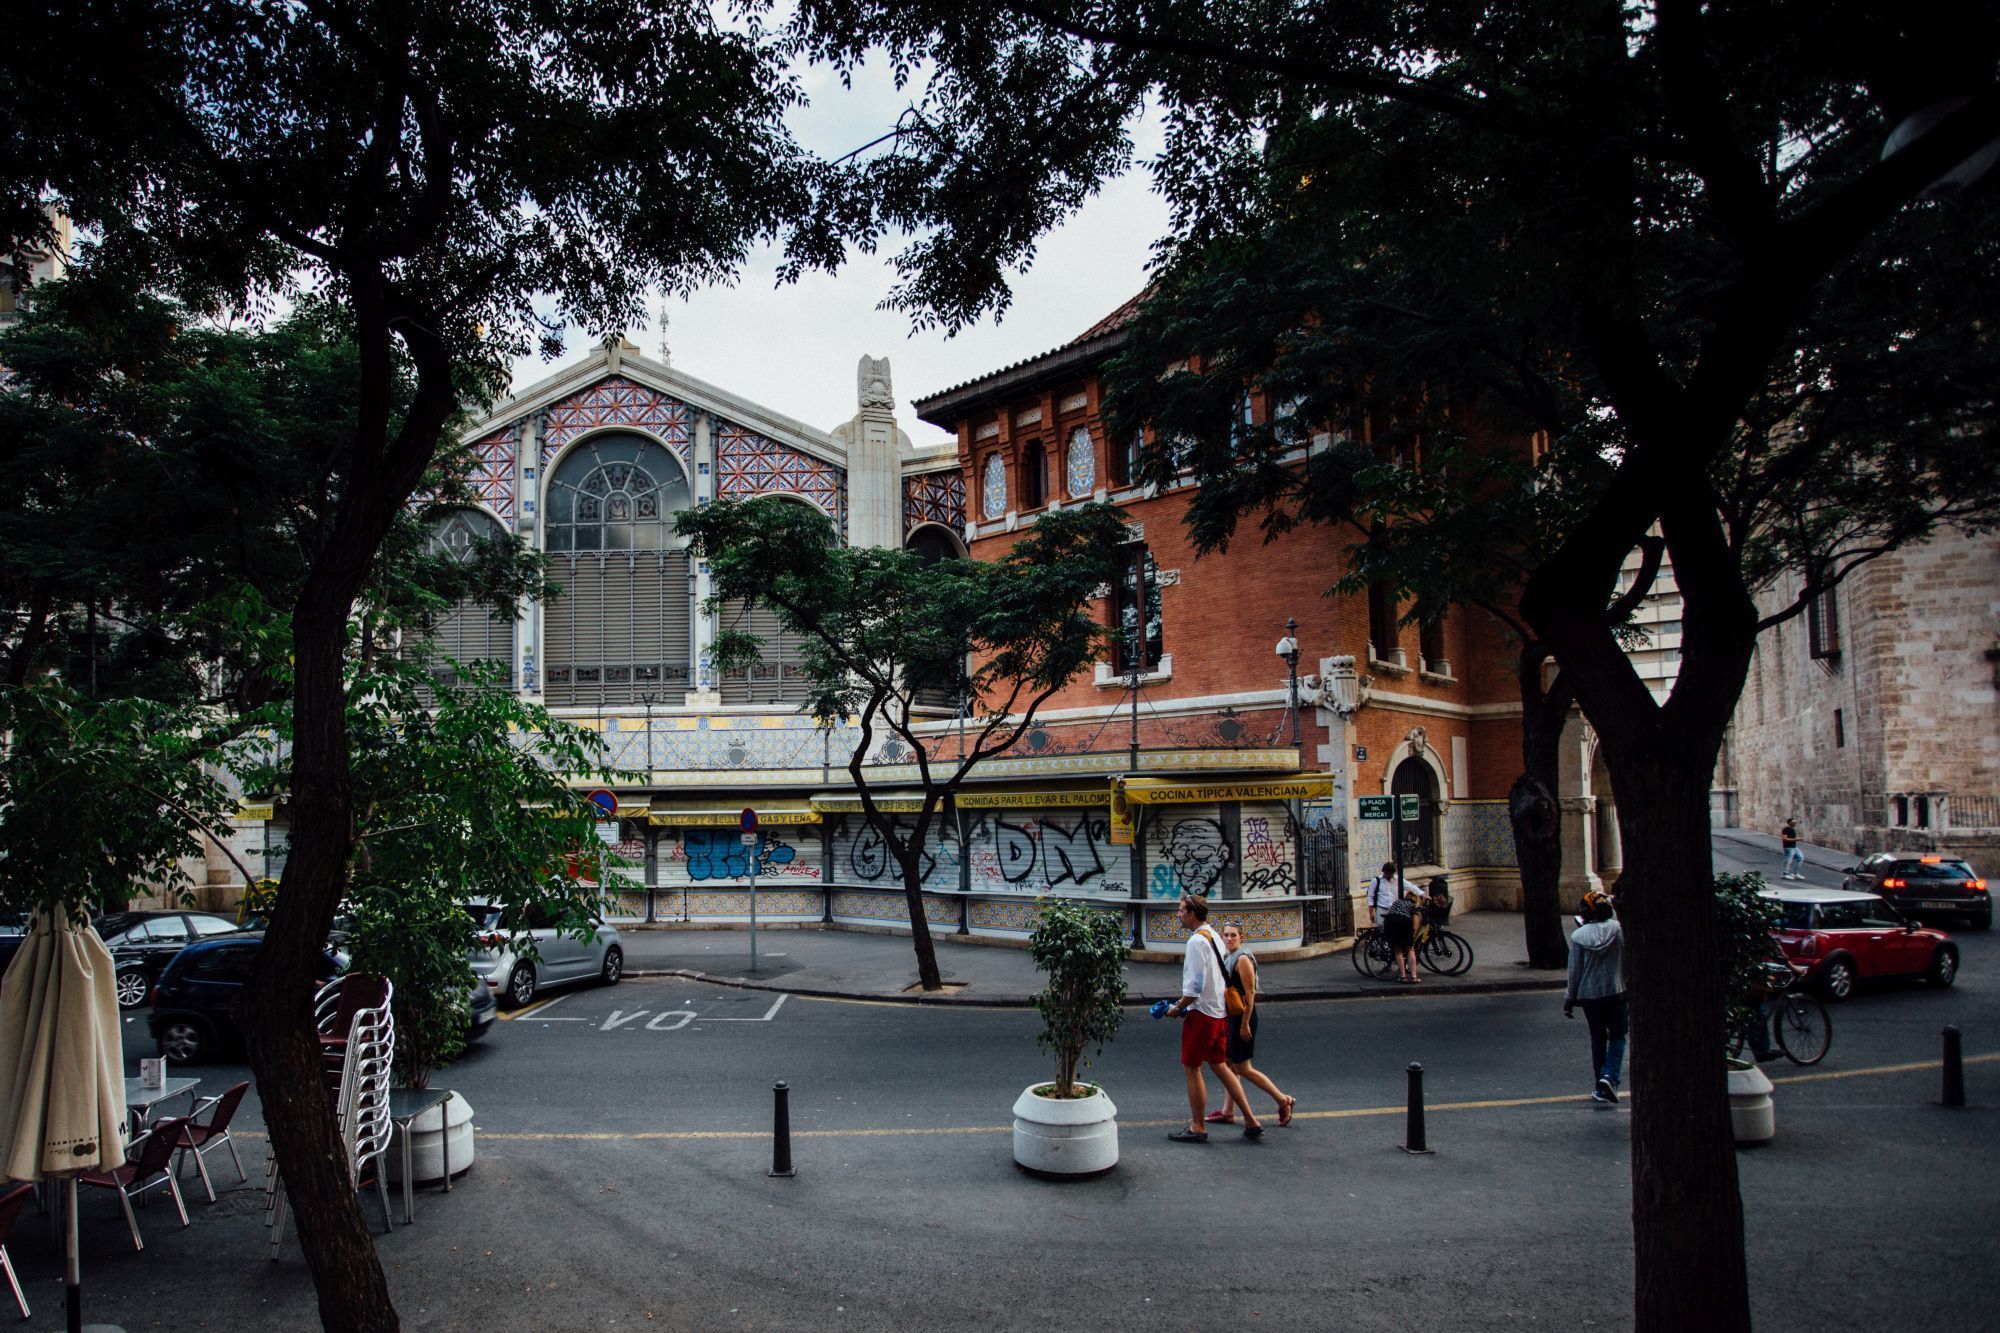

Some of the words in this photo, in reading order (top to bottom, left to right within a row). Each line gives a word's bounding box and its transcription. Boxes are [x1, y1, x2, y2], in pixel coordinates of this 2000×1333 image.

[1001, 796, 1023, 805] PARA
[1025, 795, 1056, 805] LLEVAR
[1060, 794, 1071, 804] EL
[1073, 793, 1111, 804] PALOMO
[1150, 790, 1194, 801] COCINA
[1197, 787, 1233, 799] TÍPICA
[1235, 786, 1308, 798] VALENCIANA
[760, 815, 778, 823] GAS
[781, 815, 787, 823] Y
